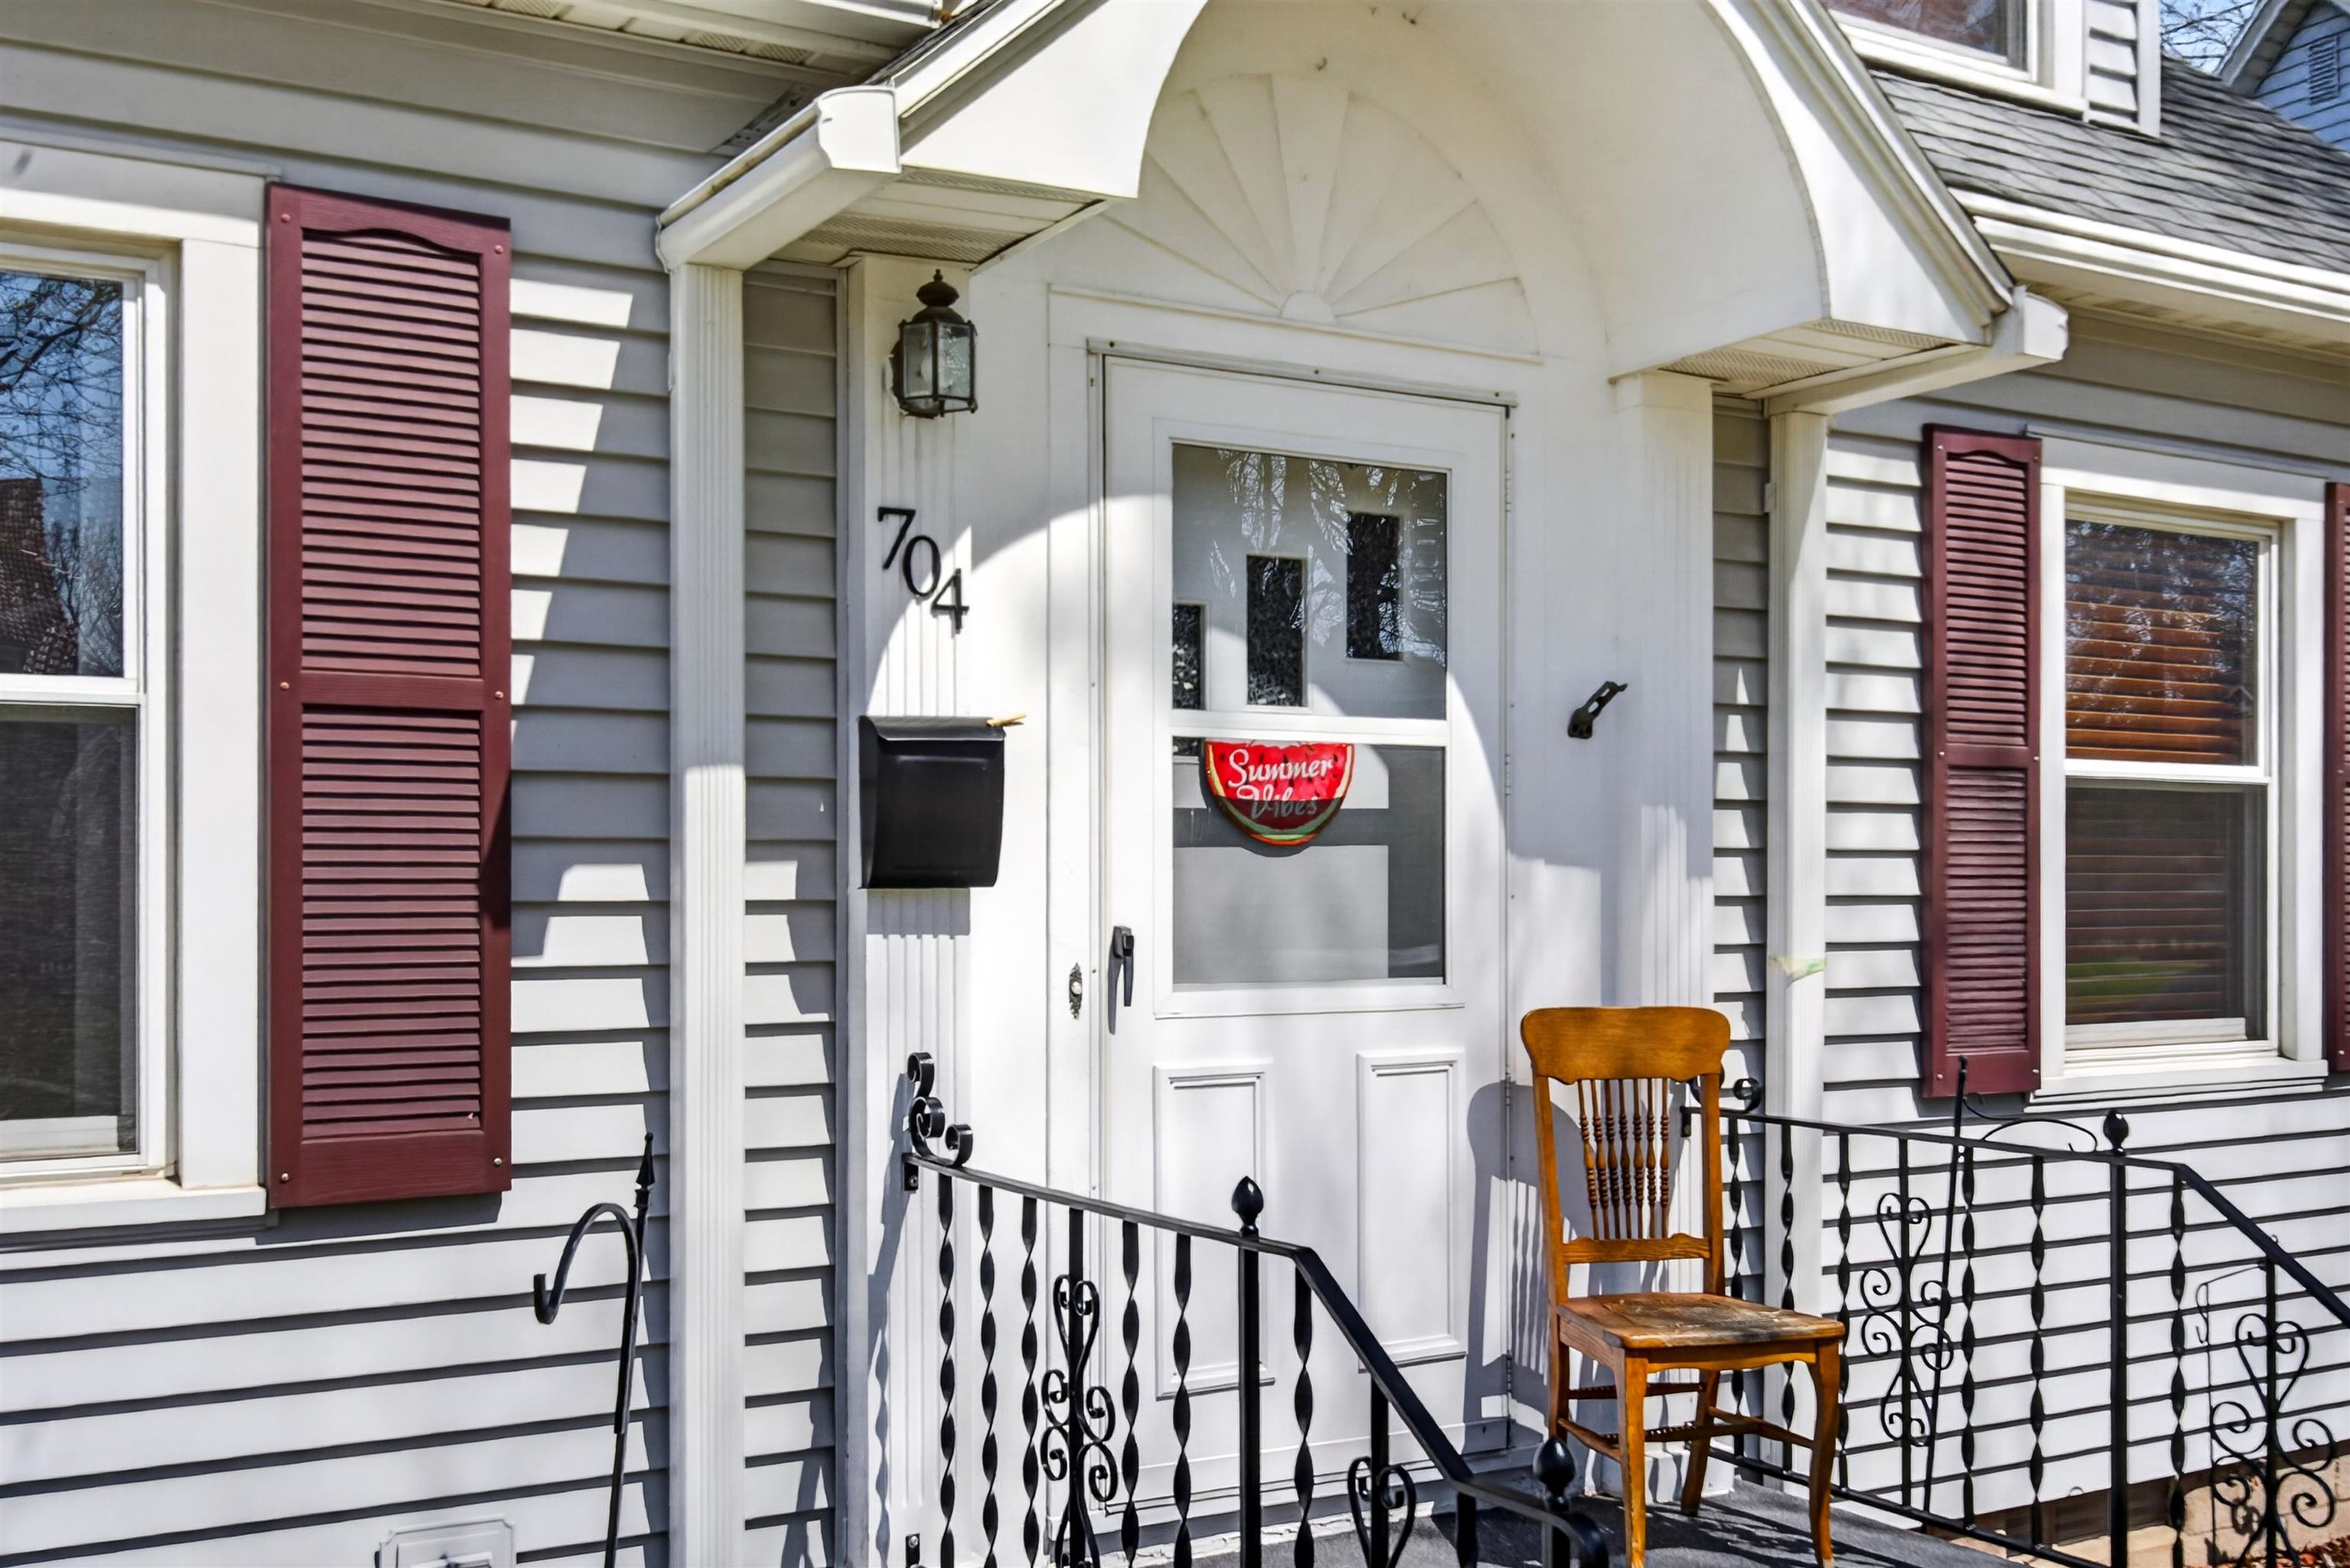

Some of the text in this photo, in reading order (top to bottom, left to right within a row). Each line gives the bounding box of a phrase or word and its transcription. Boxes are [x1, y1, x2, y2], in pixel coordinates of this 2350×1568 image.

[877, 506, 969, 634] 704
[1228, 749, 1333, 788] Summer
[1236, 784, 1320, 819] Vibes
